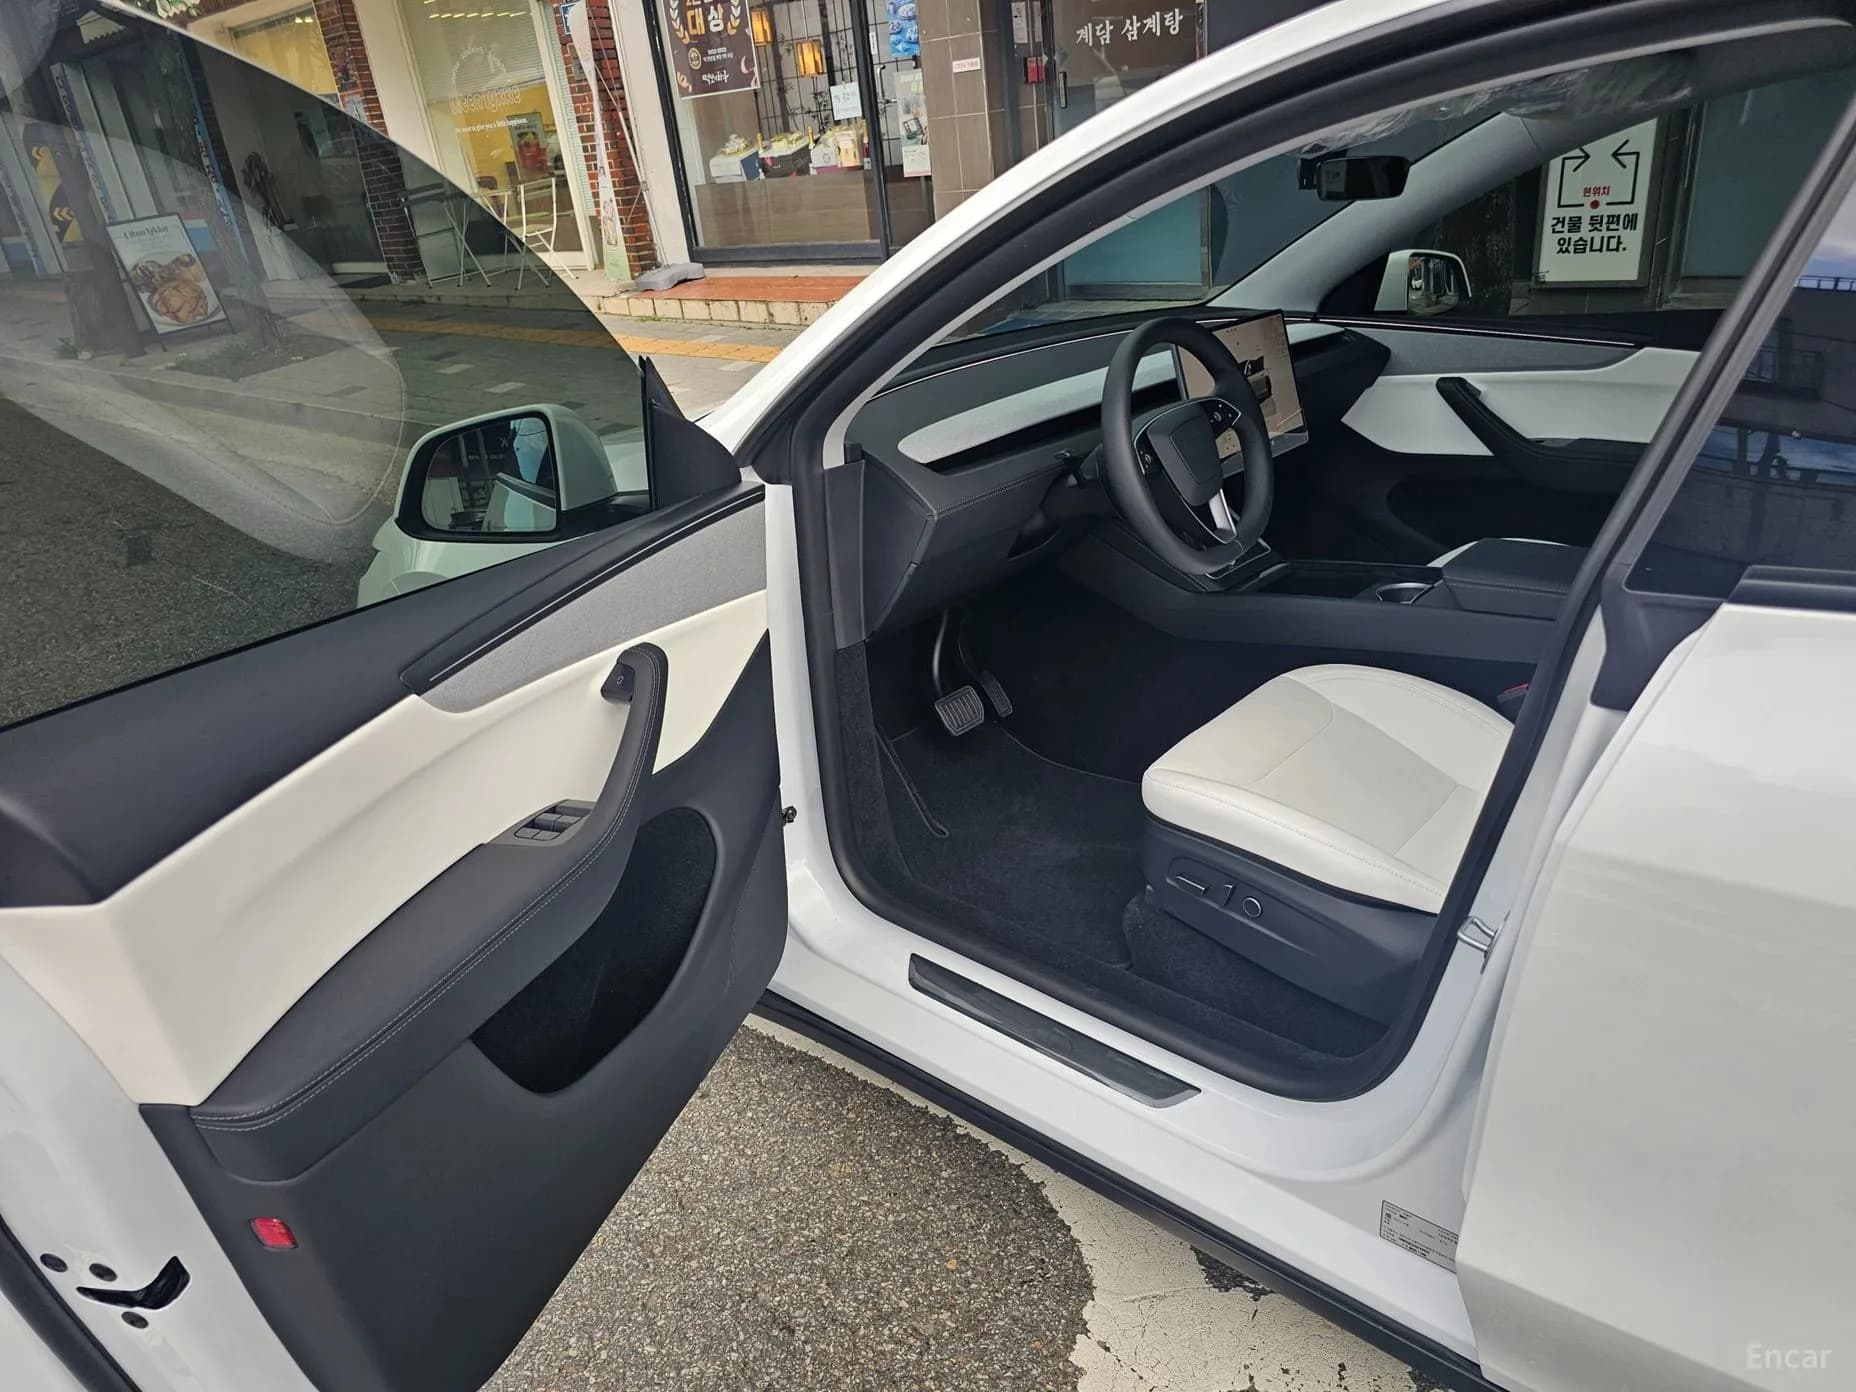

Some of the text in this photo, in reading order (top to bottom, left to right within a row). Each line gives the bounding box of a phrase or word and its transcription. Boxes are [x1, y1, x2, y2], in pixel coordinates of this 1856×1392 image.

[686, 3, 724, 35] 대상
[1076, 8, 1184, 47] 계담 삼계탕
[1583, 185, 1611, 198] 현위치
[1551, 213, 1639, 234] 건물 뒷편에
[1556, 235, 1627, 255] 있습니다.
